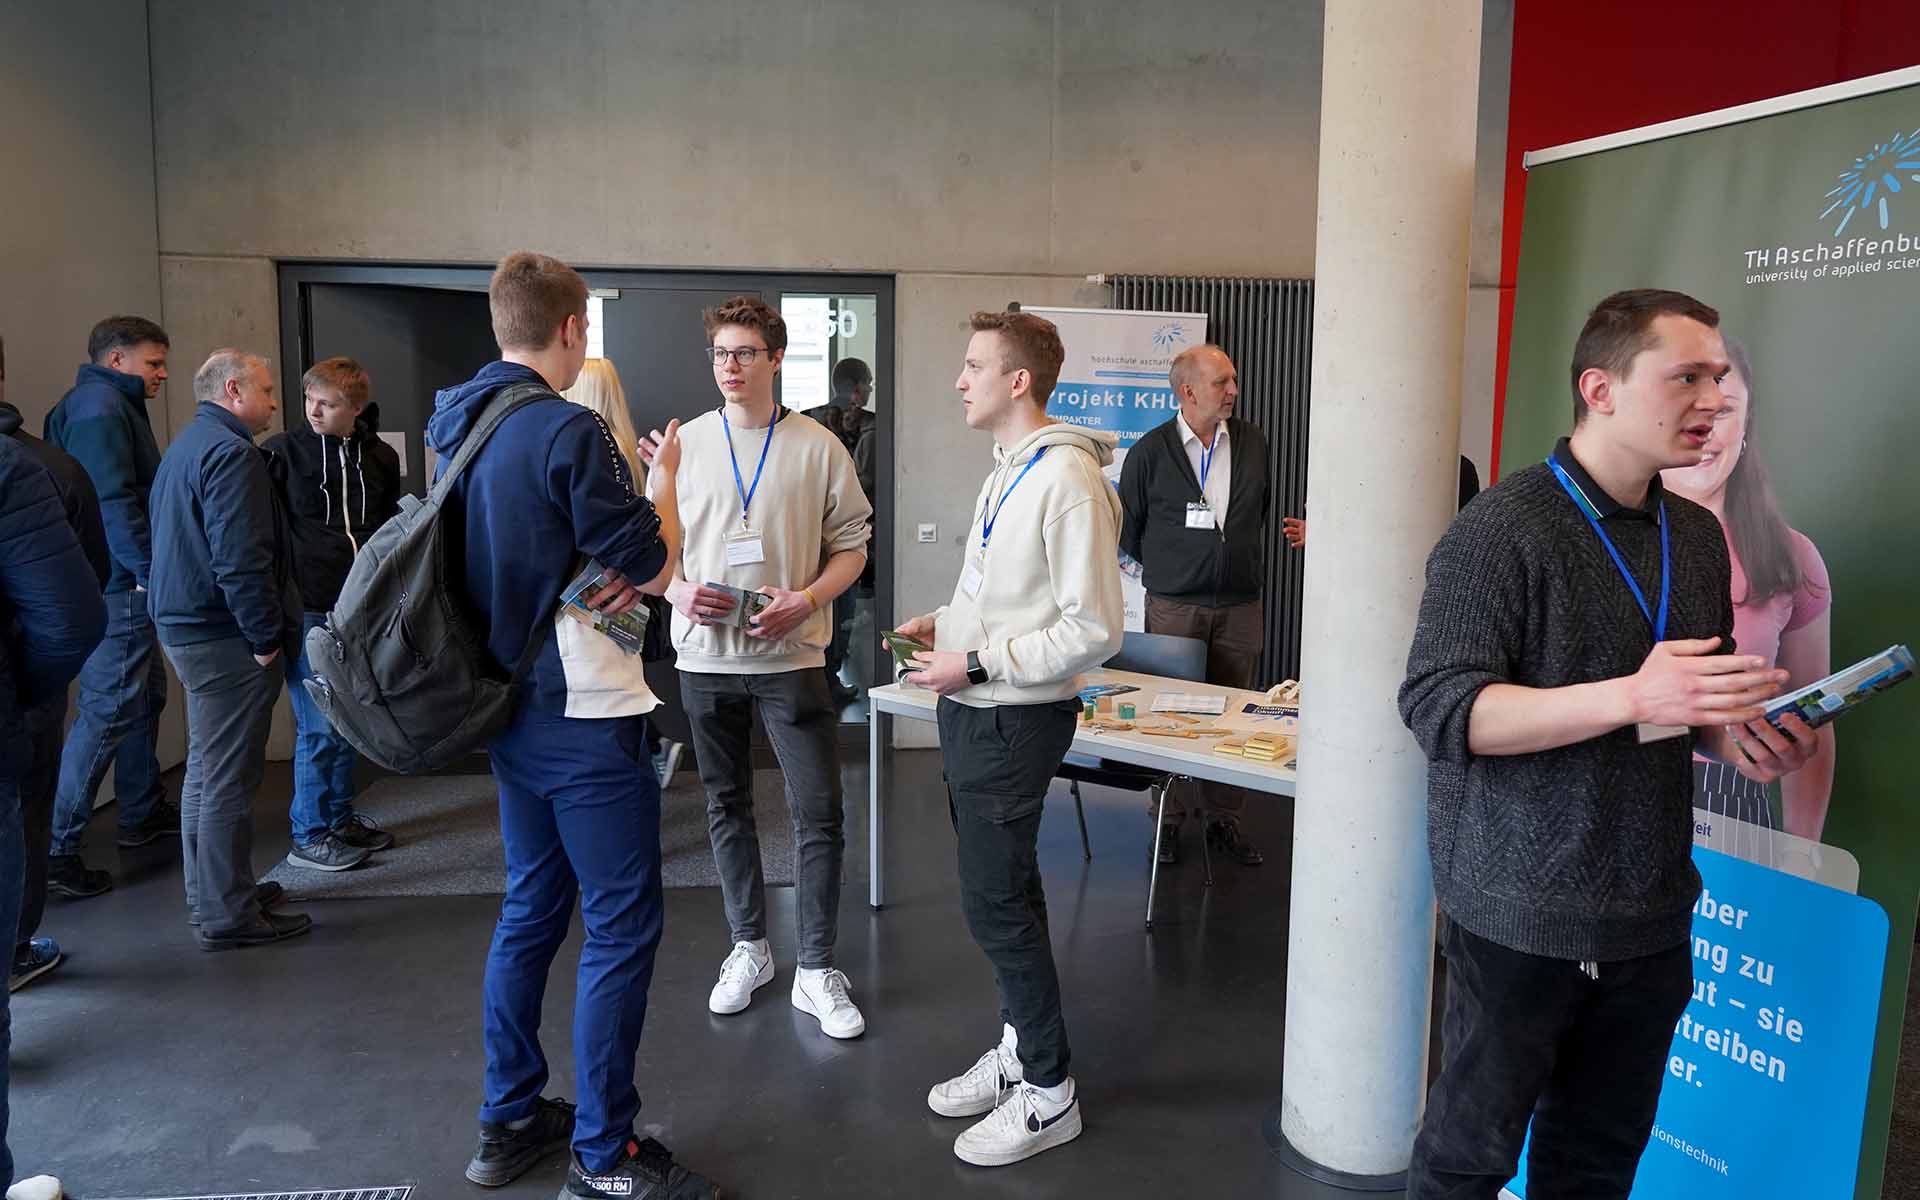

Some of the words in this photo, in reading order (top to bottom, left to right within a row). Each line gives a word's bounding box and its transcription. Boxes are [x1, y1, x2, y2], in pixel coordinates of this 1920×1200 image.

[1744, 249, 1769, 269] TH
[1746, 267, 1808, 284] university
[1813, 264, 1828, 278] of
[1831, 259, 1881, 278] applied
[1050, 389, 1125, 409] rojekt
[1047, 414, 1102, 425] MPAKTER
[1693, 820, 1712, 838] eit
[1691, 934, 1729, 975] ng
[1738, 953, 1775, 986] zu
[1757, 1006, 1804, 1043] sie
[1666, 1055, 1703, 1088] er.
[613, 1181, 628, 1192] RM
